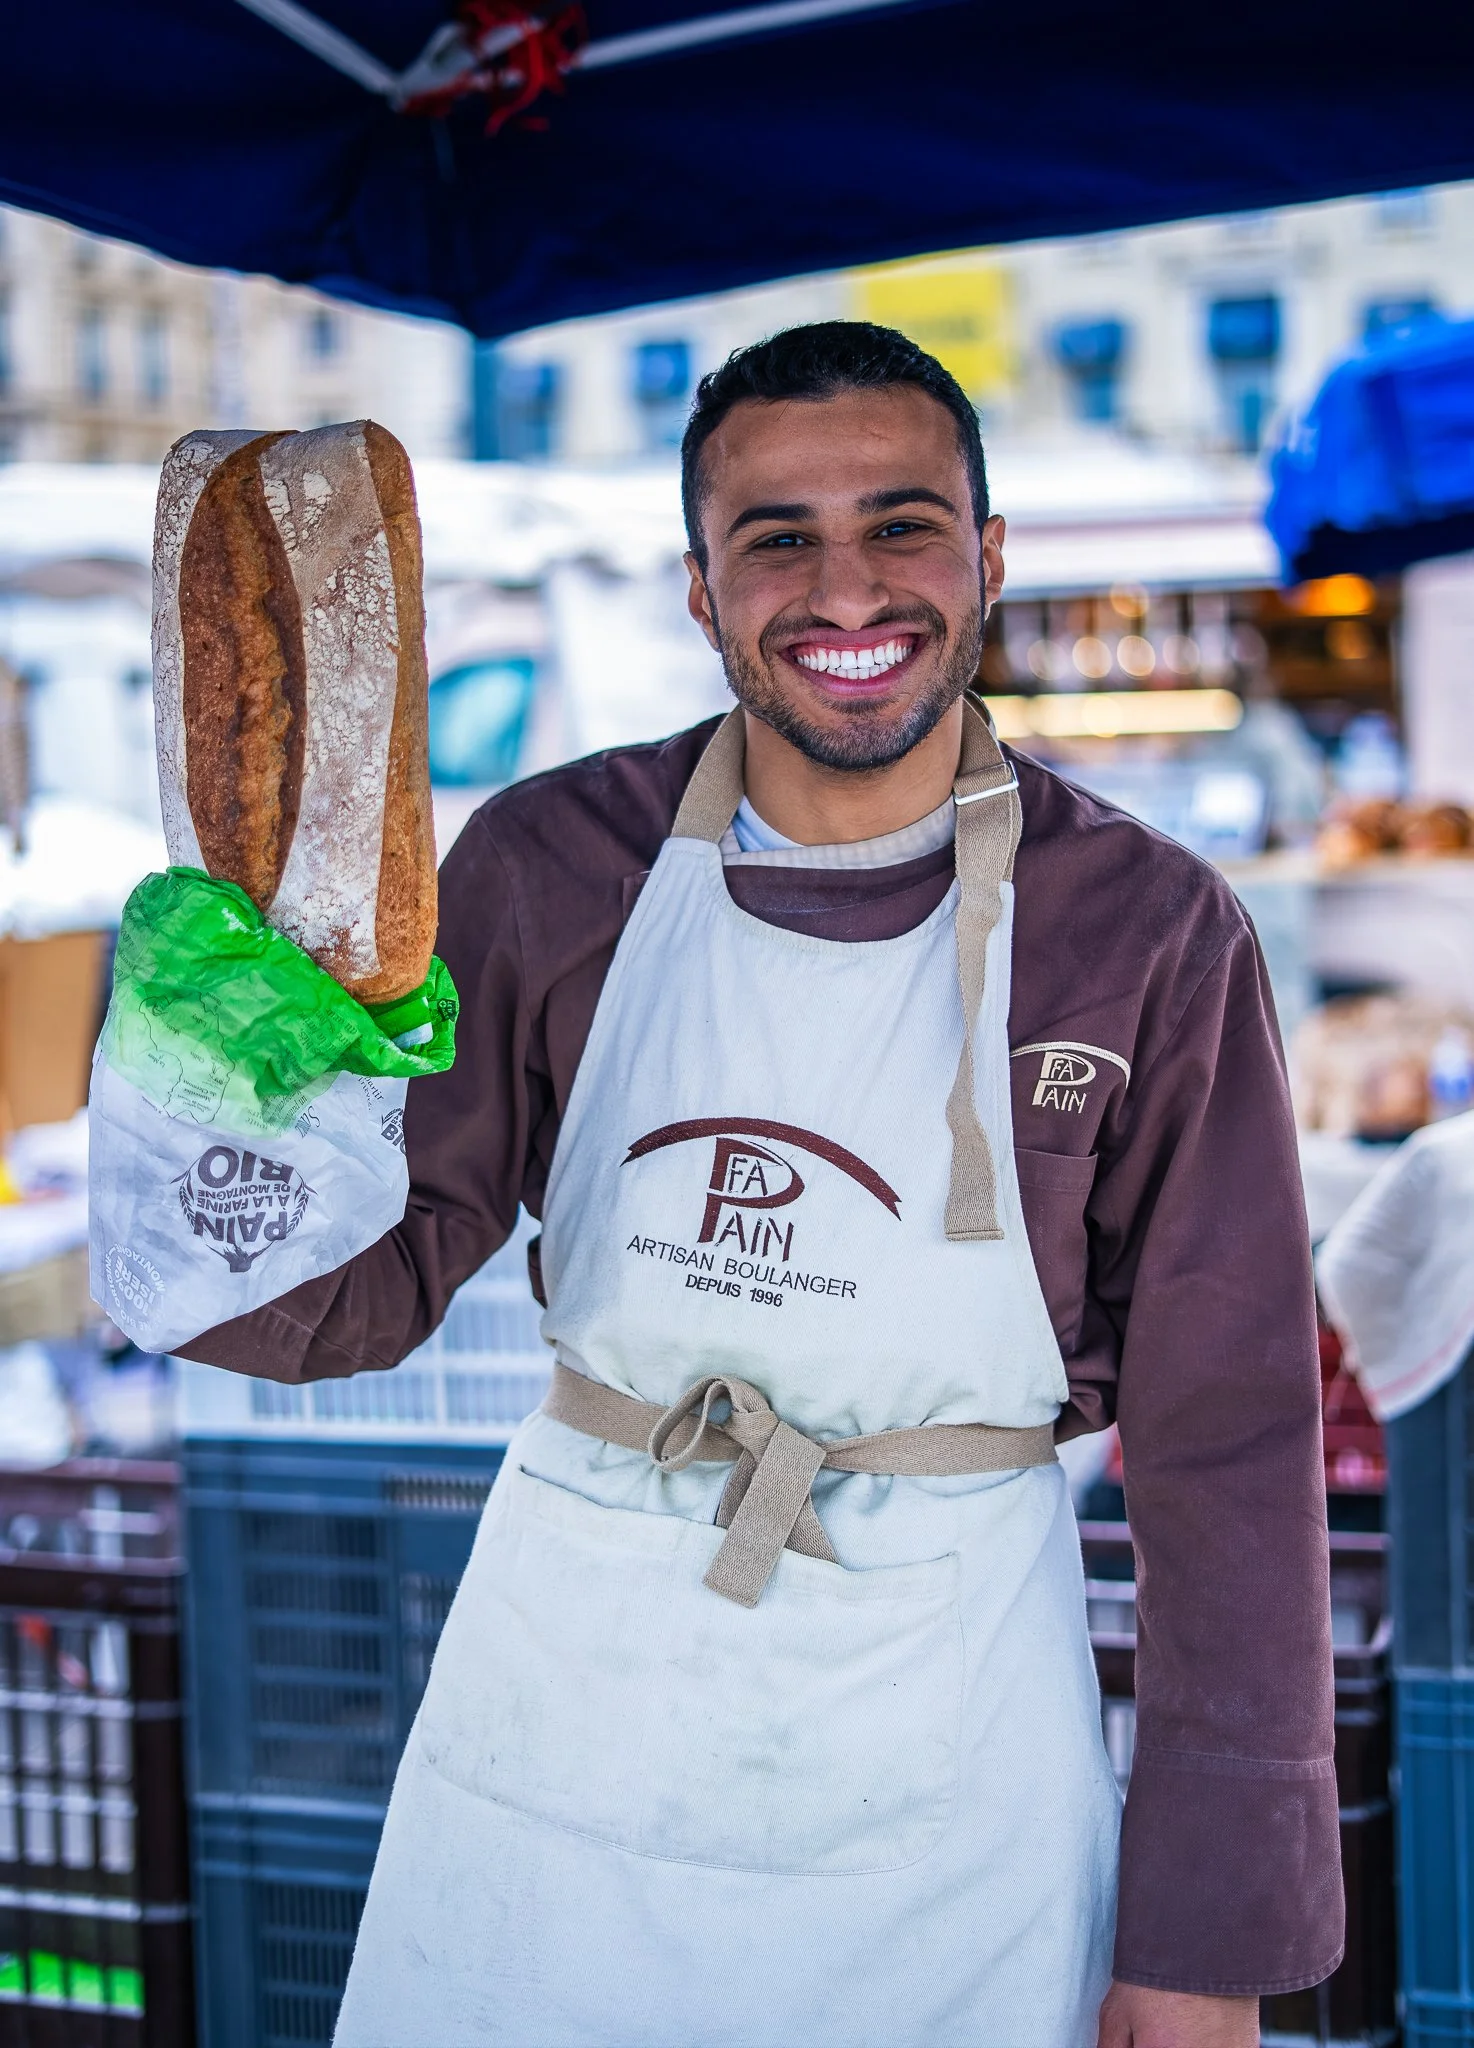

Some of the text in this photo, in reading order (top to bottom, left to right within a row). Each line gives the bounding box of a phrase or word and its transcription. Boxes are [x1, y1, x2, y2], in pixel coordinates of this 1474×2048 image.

[1032, 1051, 1097, 1114] PAIN
[1051, 1059, 1074, 1080] FA
[197, 1145, 294, 1189] BIO
[727, 1156, 768, 1197] FA
[196, 1197, 249, 1214] FARINE
[197, 1183, 291, 1200] DE MONTAGNE
[252, 1195, 273, 1209] LA
[697, 1137, 805, 1262] PAIN
[194, 1211, 288, 1245] PAIN
[626, 1235, 857, 1299] ARTISAN BOULANGER
[114, 1269, 149, 1317] 100%
[685, 1274, 784, 1307] DEPUIS 1996
